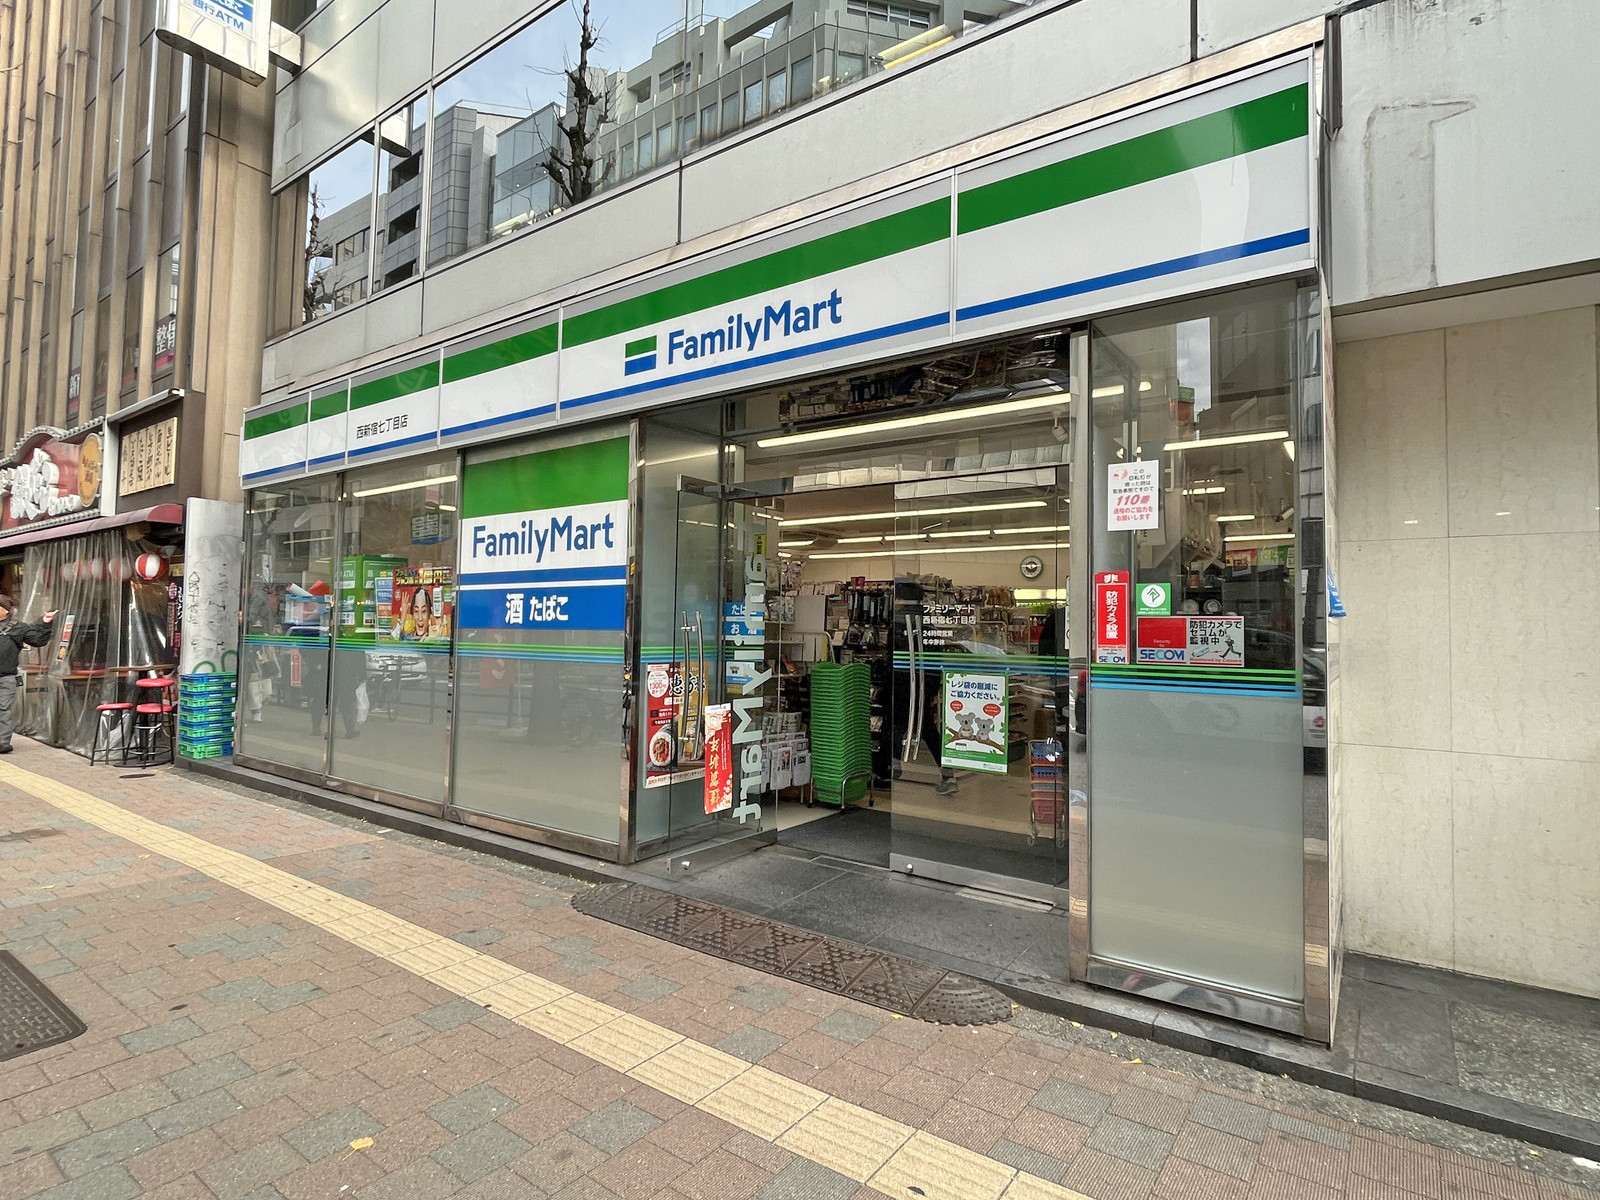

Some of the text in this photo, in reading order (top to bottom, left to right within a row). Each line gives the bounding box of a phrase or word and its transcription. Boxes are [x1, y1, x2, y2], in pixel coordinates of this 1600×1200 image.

[668, 288, 842, 365] FamilyMart
[356, 414, 408, 439] 西新宿七丁目店
[1117, 494, 1150, 506] 110番
[1116, 513, 1151, 521] お願いします
[472, 513, 614, 563] FamilyMart
[505, 592, 569, 625] 酒 たばこ
[923, 604, 976, 613] ファミリーマート
[1105, 590, 1119, 639] 防犯カメラ設置
[923, 615, 976, 625] 西新宿七丁目店
[1189, 620, 1242, 629] 防犯カメラで
[1189, 628, 1227, 637] セコムが
[1189, 636, 1220, 645] 監視中
[1140, 649, 1185, 661] SECOM
[951, 681, 998, 690] レジ袋の削減に
[950, 690, 1000, 700] ご協力ください。
